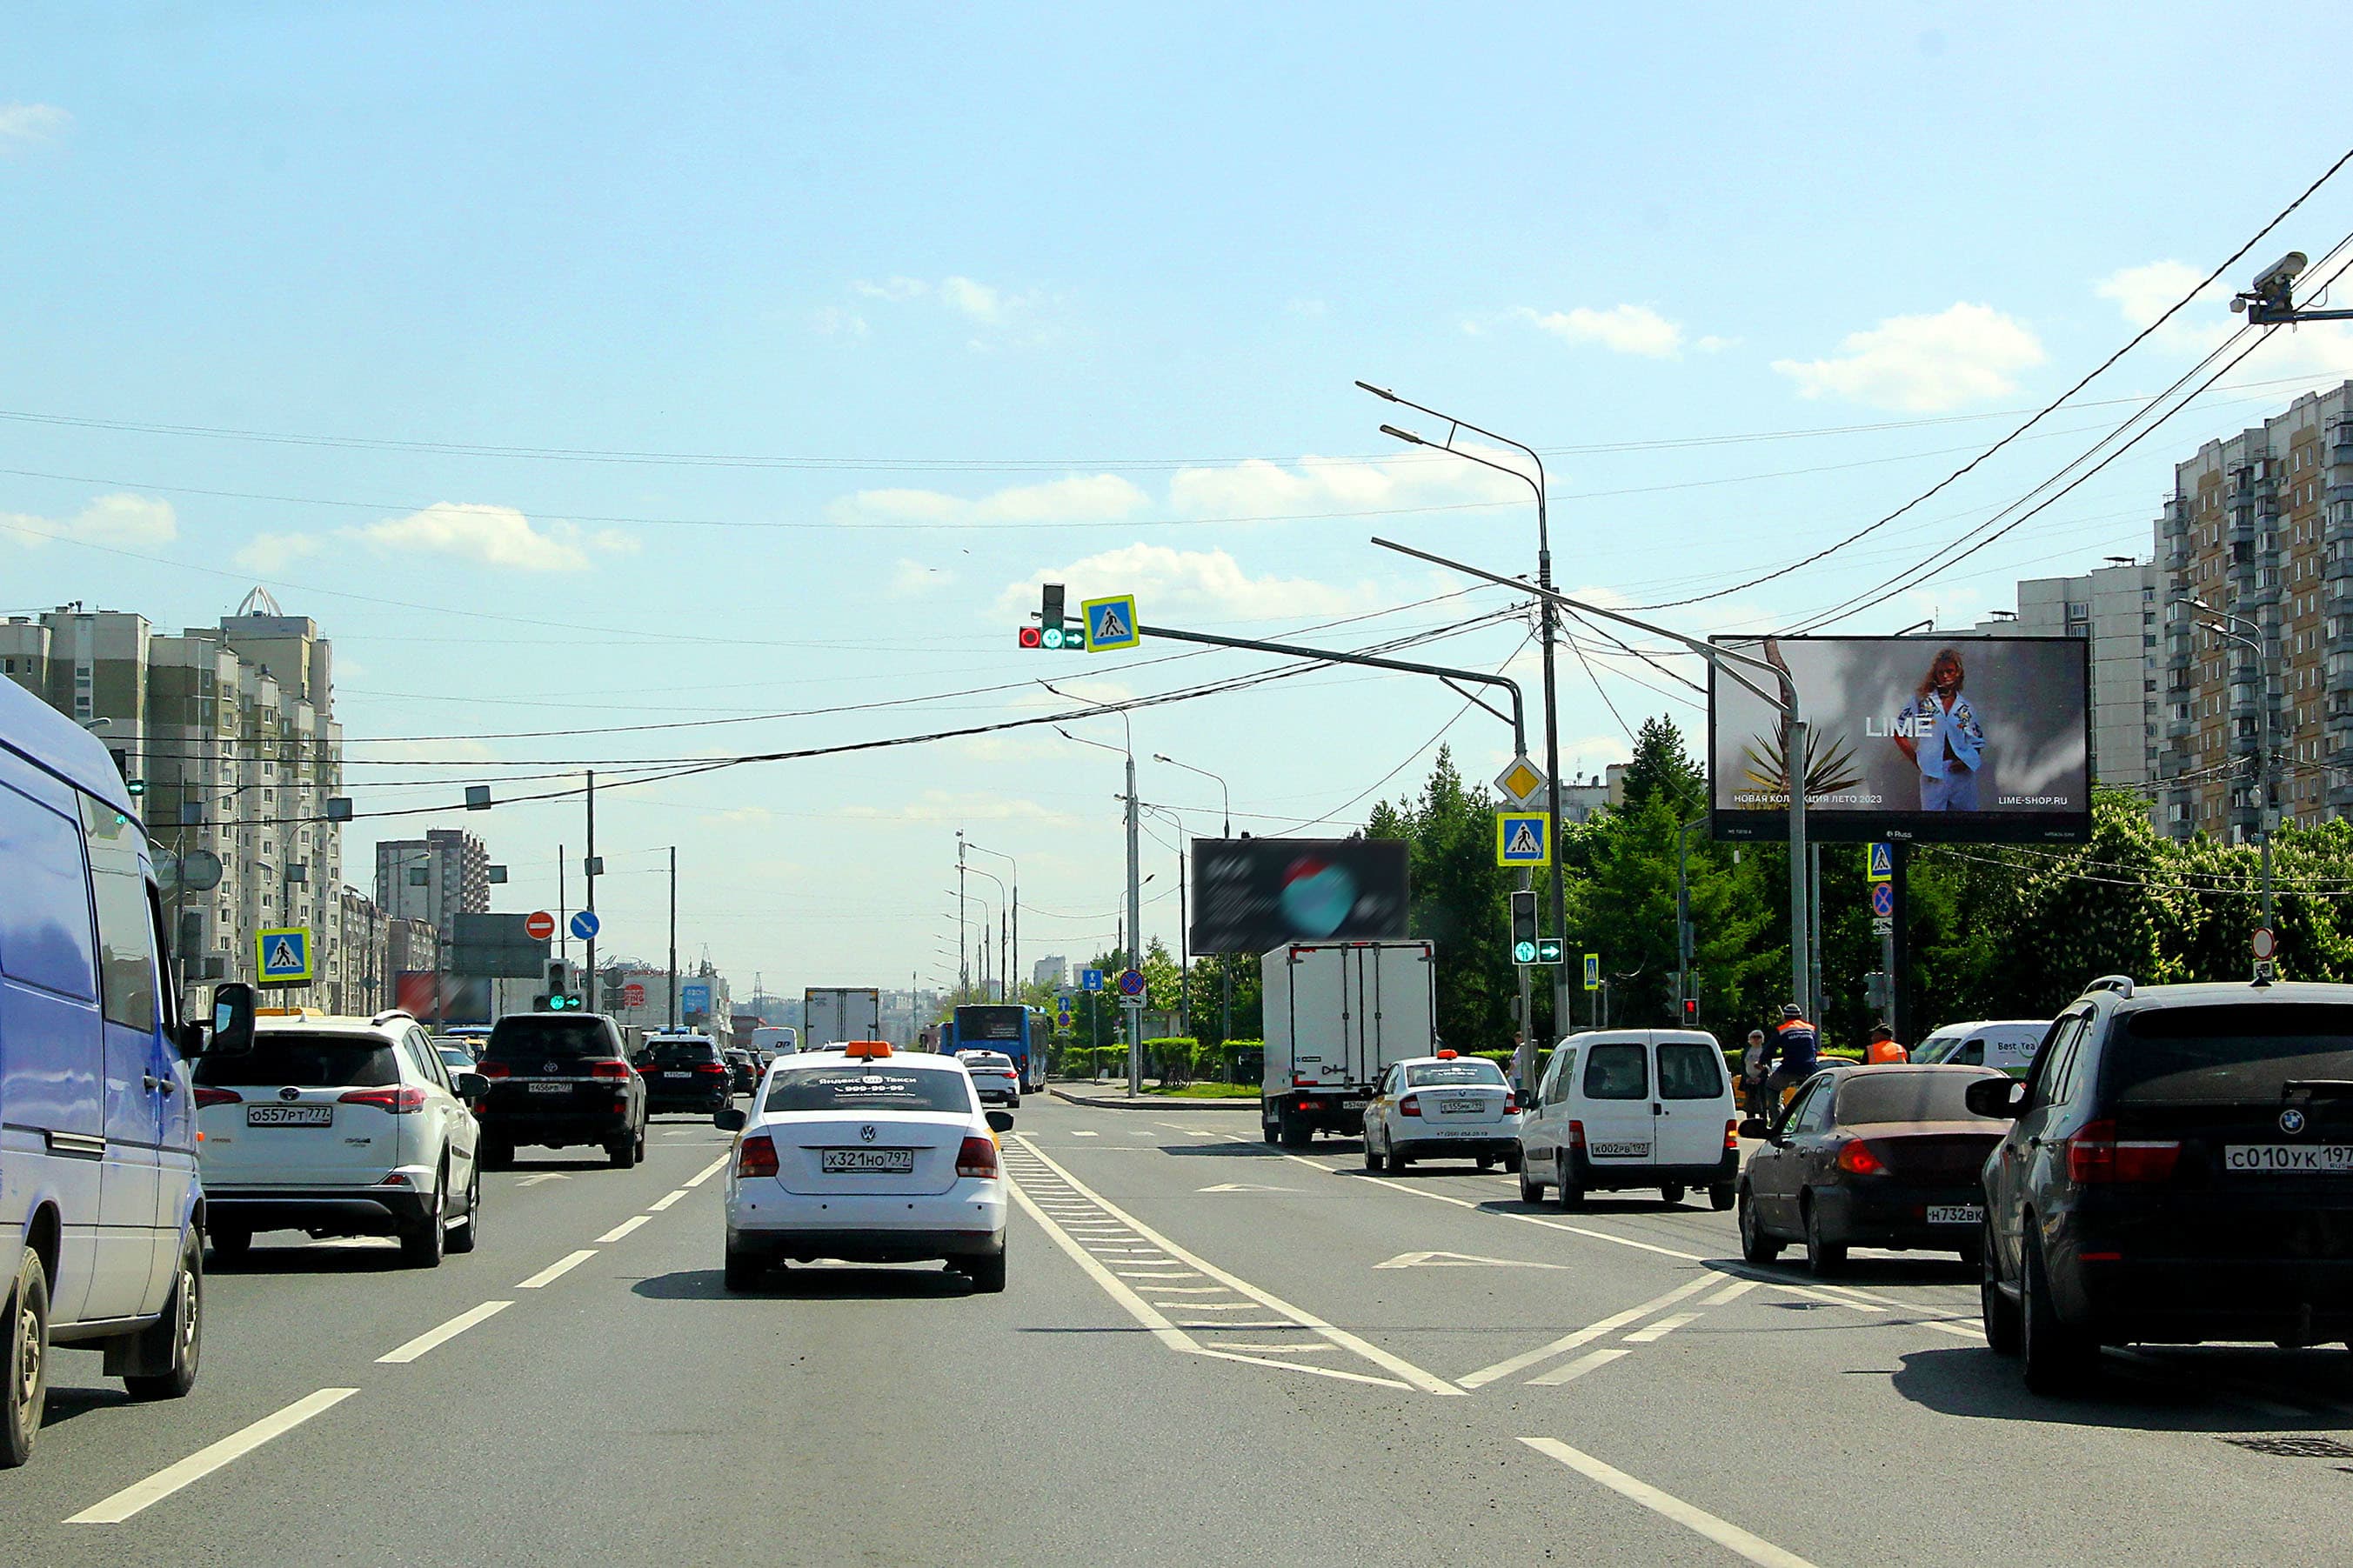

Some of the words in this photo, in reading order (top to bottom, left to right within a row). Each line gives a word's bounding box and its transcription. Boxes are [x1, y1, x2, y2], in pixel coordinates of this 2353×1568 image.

[1734, 794, 1768, 803] НОВАЯ
[1769, 794, 1829, 804] КОЛКЦИЯ
[1831, 794, 1857, 804] ЛЕТО
[1859, 795, 1882, 804] 2023
[1998, 796, 2068, 805] LIME-SHOP.RU
[1997, 1042, 2017, 1051] Best
[2021, 1042, 2035, 1051] Tea
[2232, 1147, 2317, 1168] С010УК
